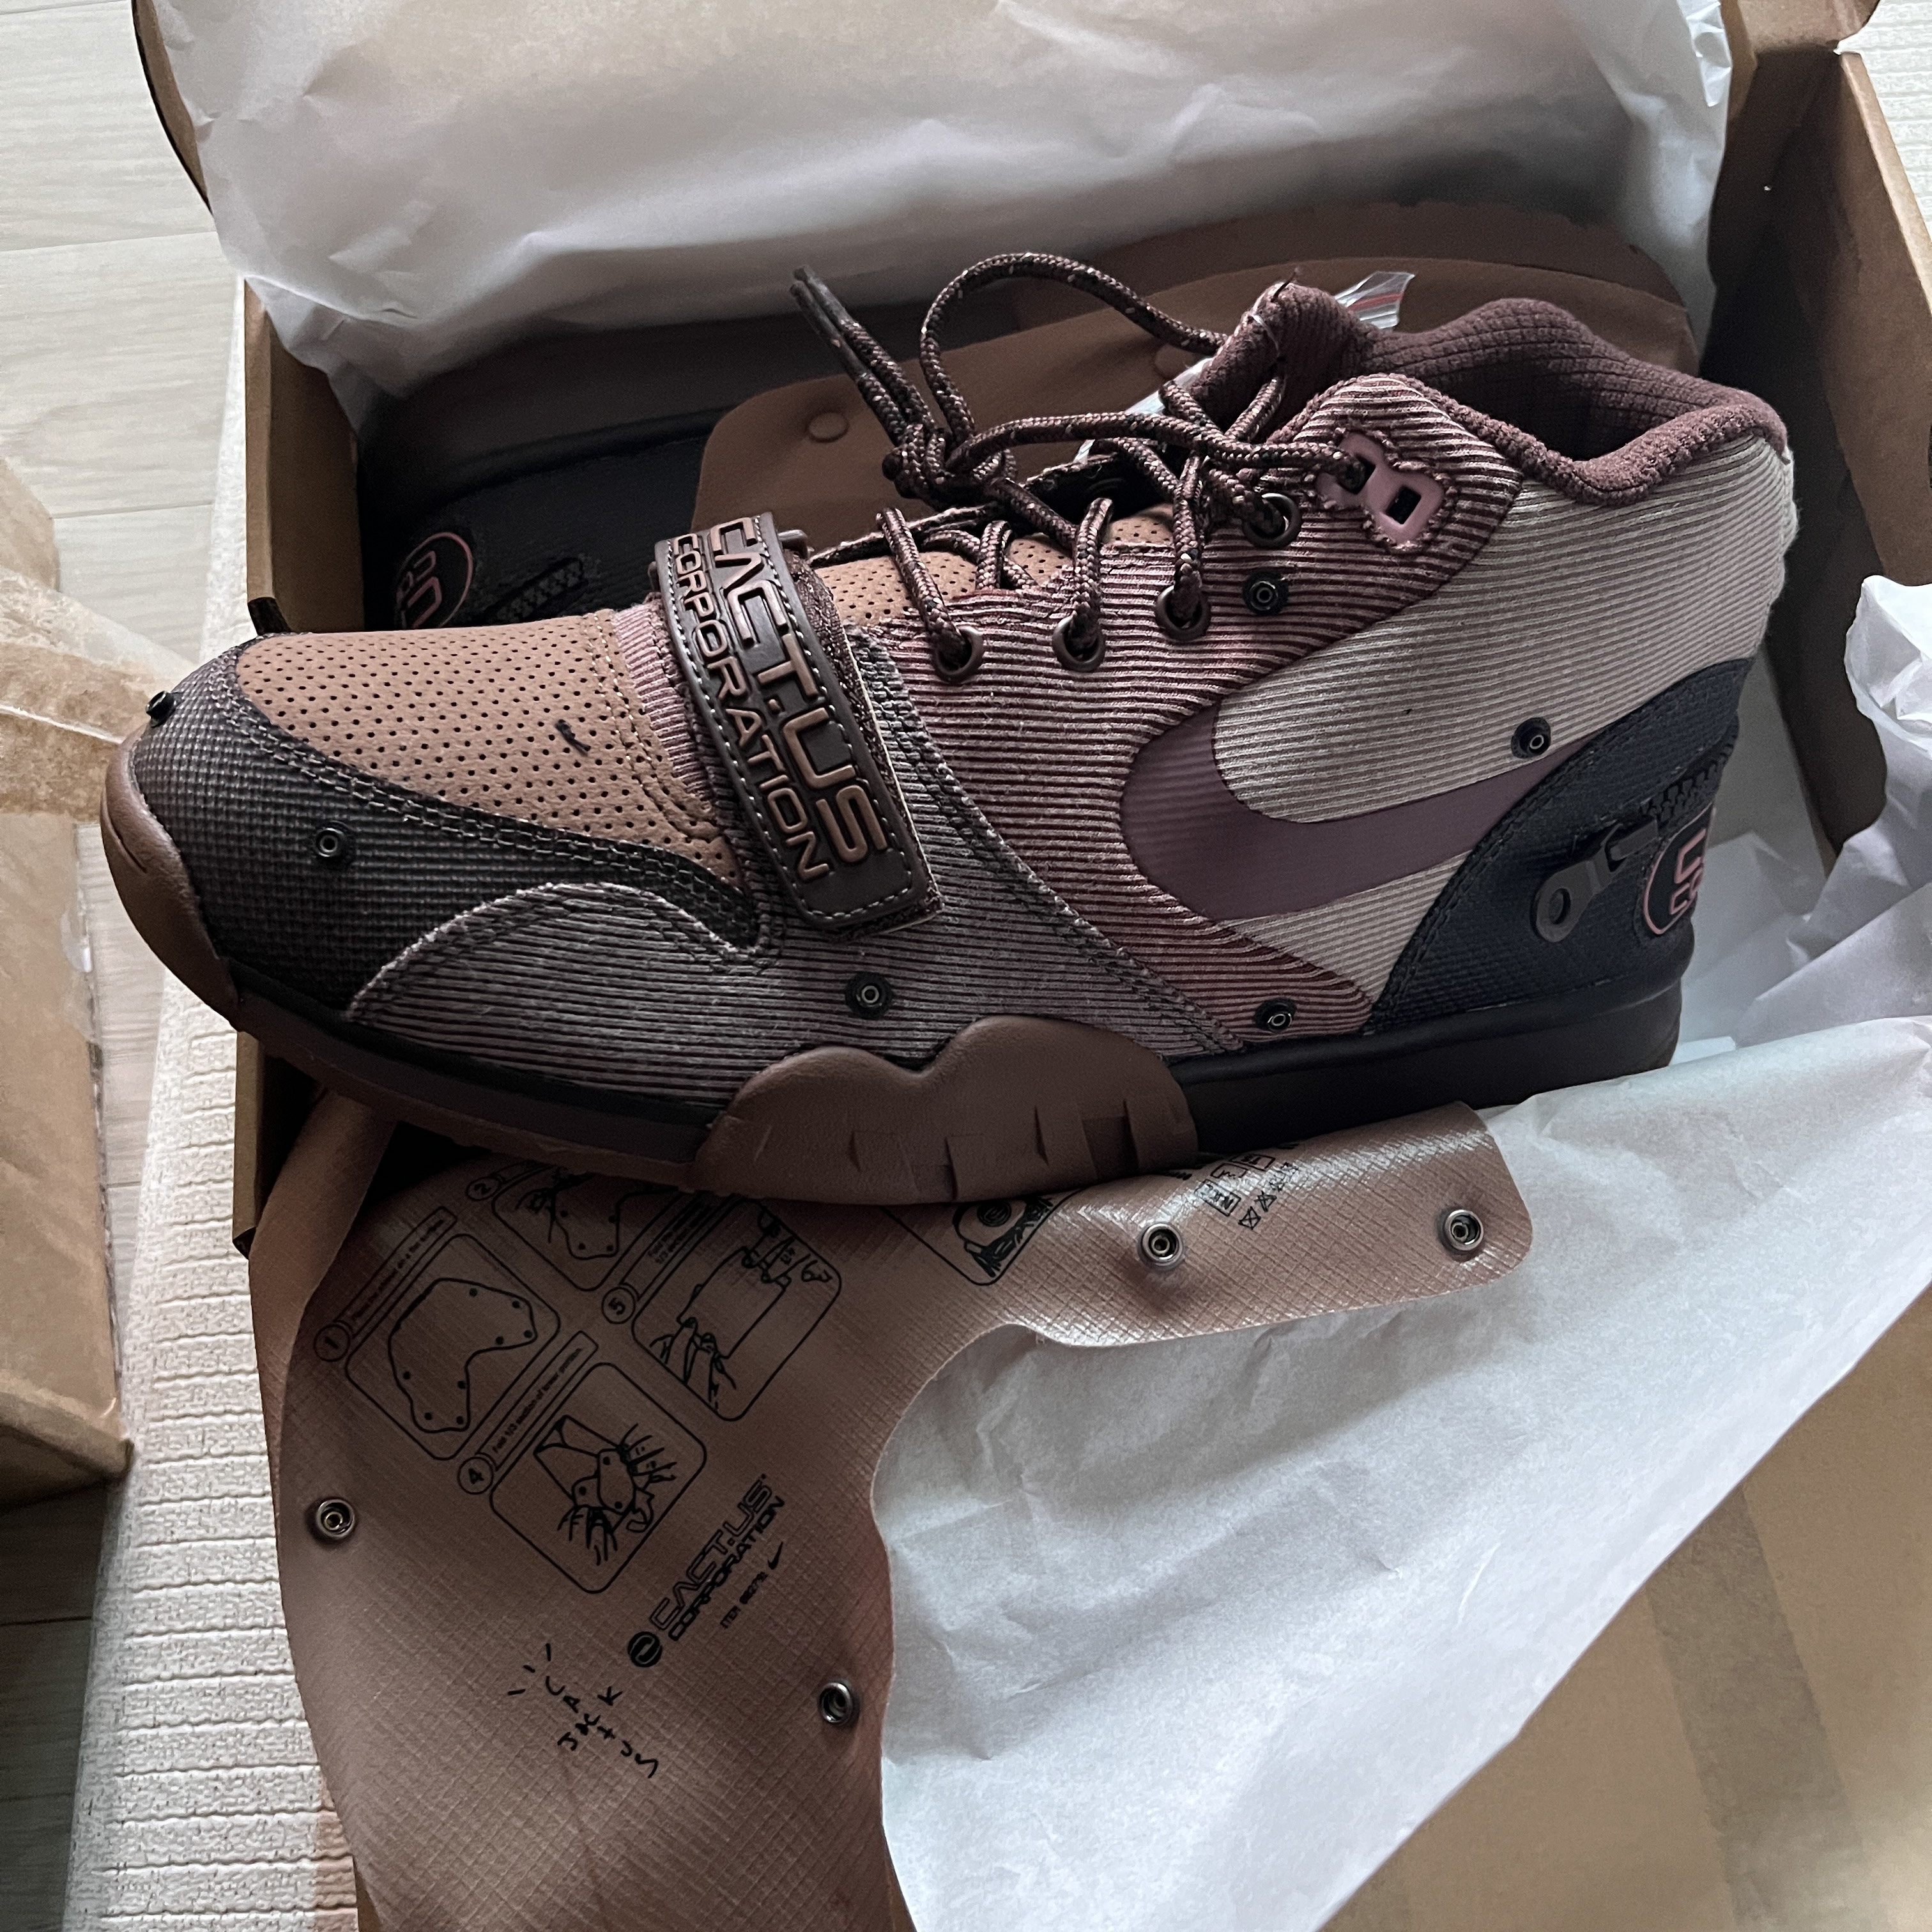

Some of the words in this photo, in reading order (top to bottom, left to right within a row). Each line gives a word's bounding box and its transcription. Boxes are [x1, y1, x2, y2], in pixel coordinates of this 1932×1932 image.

[672, 532, 831, 882] CORPORATION
[608, 1297, 626, 1315] 5
[324, 1335, 339, 1351] 1
[468, 1468, 485, 1485] 4
[668, 1495, 785, 1641] CORPORATION
